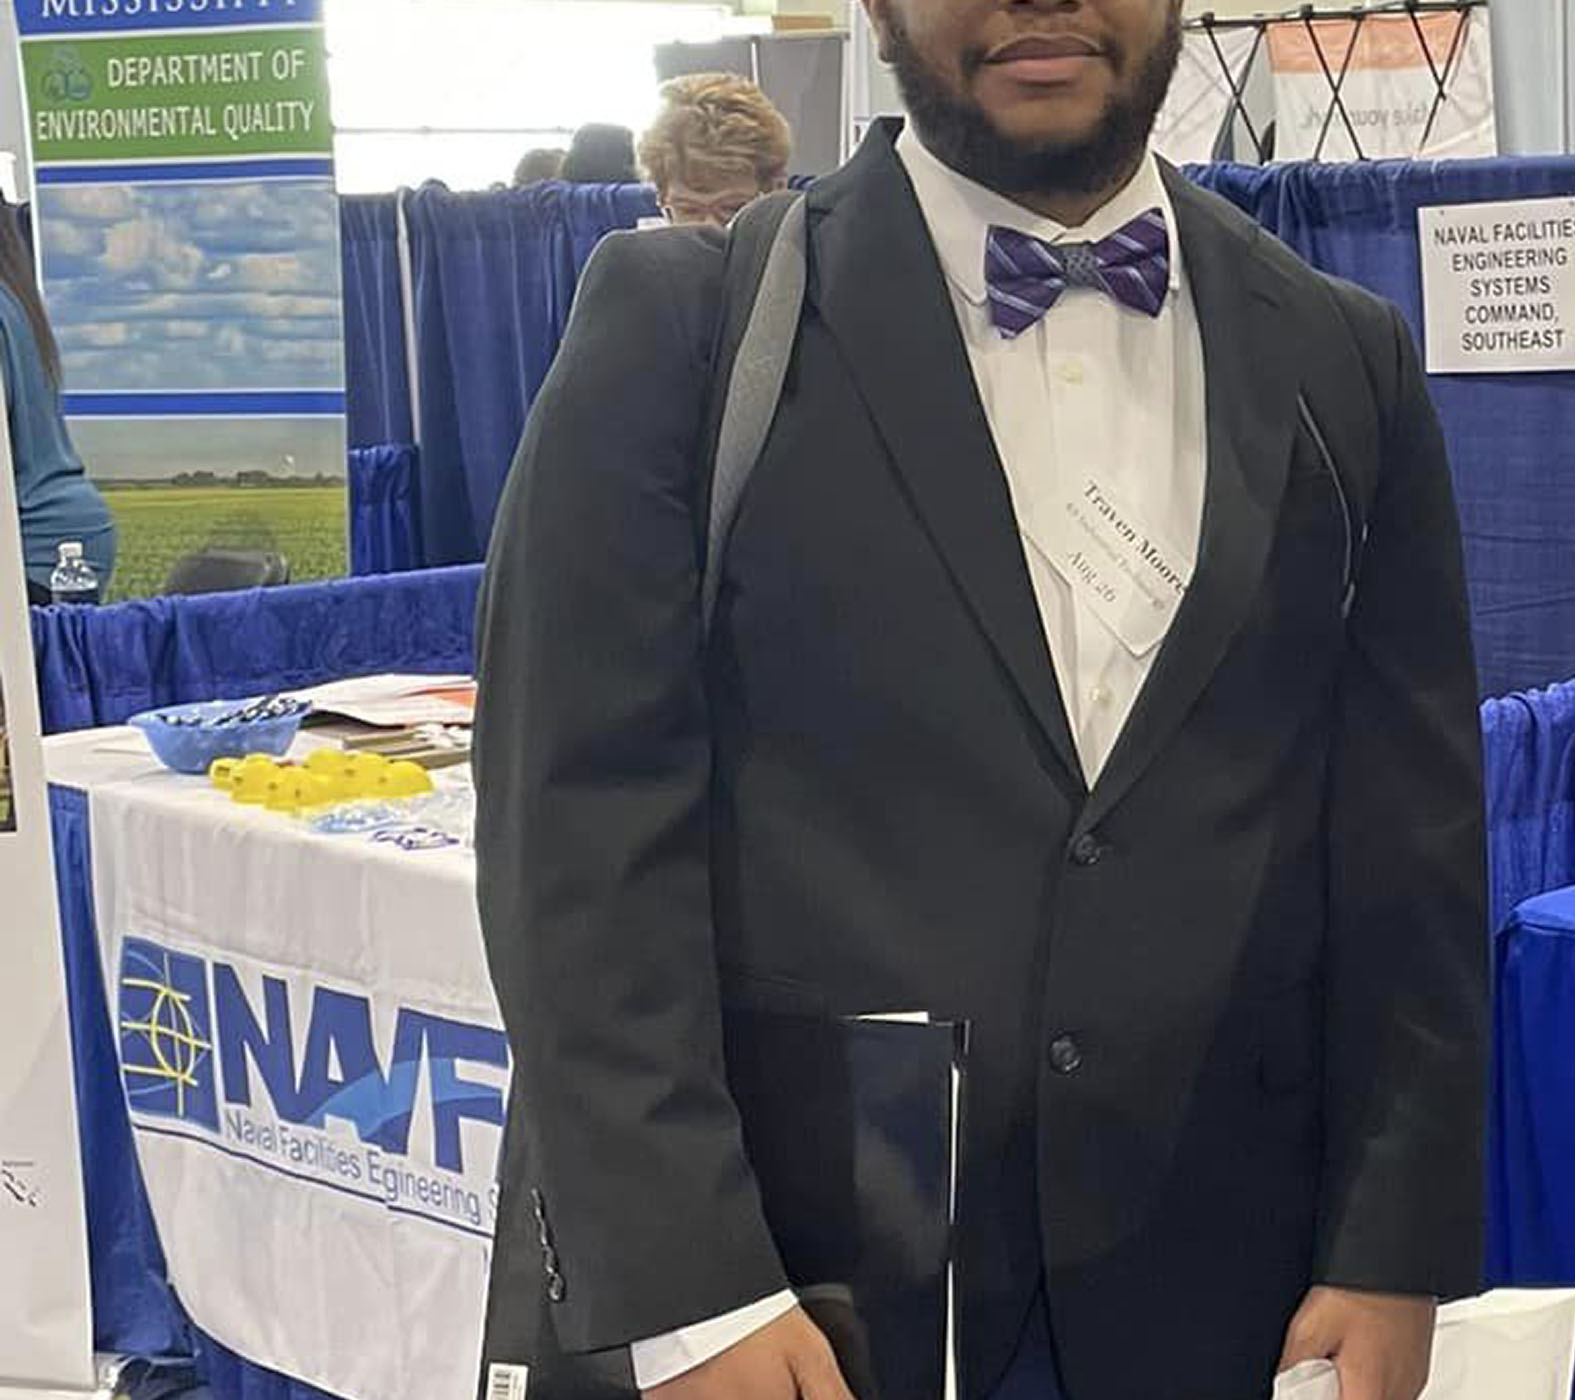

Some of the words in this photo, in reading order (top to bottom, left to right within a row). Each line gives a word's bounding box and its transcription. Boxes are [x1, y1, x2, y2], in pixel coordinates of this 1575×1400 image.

[108, 51, 263, 88] DEPARTMENT
[272, 49, 305, 80] OF
[36, 105, 216, 141] ENVIRONMENTAL
[223, 101, 314, 141] QUALITY
[1434, 225, 1489, 245] NAVAL
[1452, 247, 1568, 272] ENGINEERING
[1470, 275, 1551, 298] SYSTEMS
[1465, 302, 1560, 325] COMMAND,
[1462, 329, 1565, 351] SOUTHEAST
